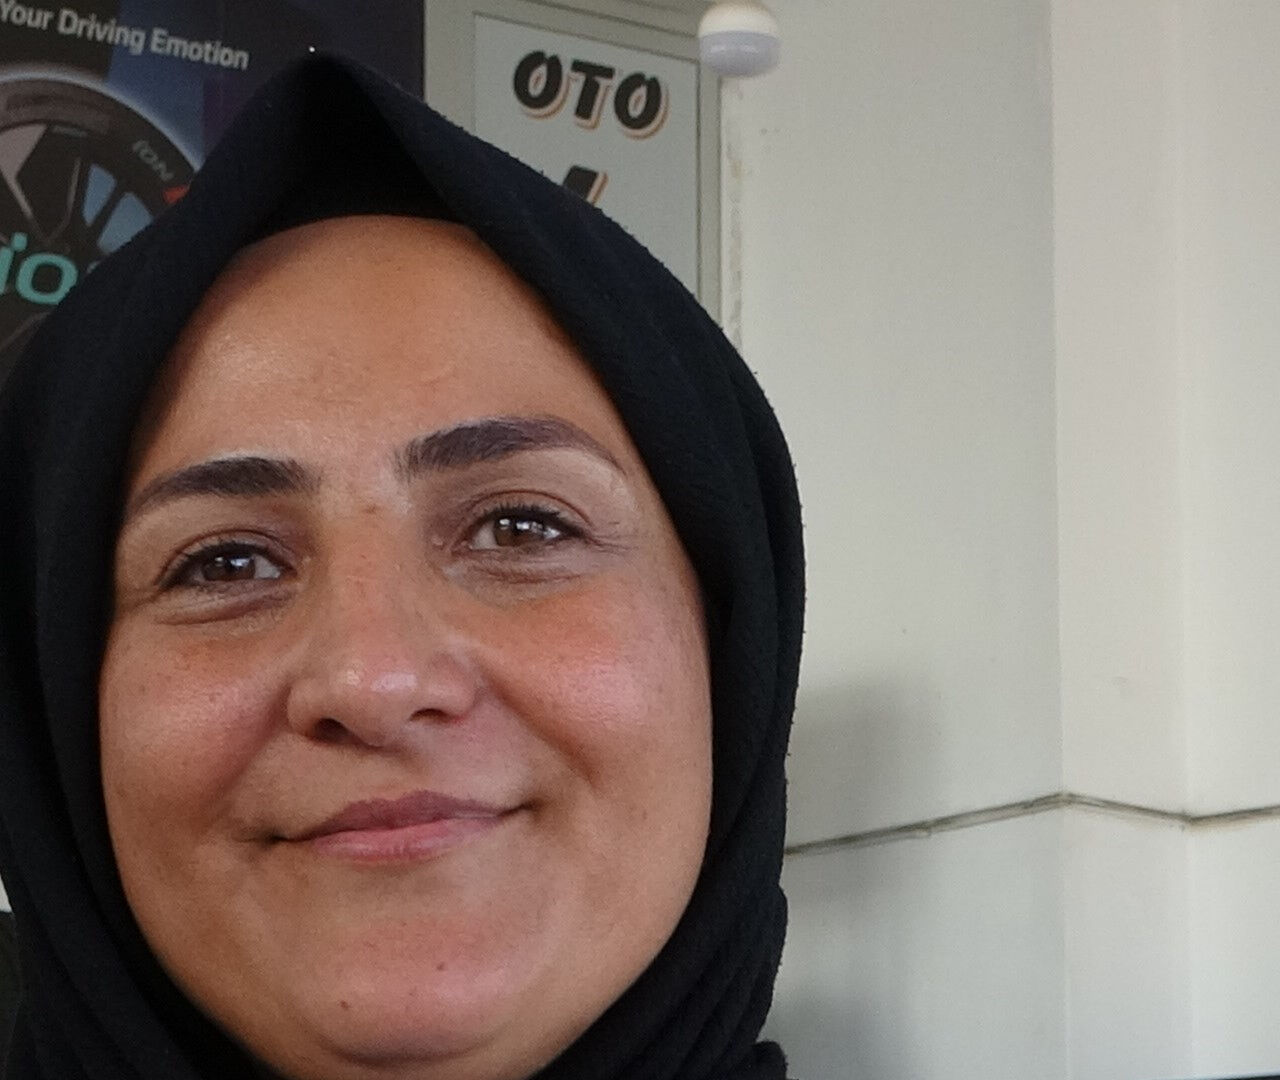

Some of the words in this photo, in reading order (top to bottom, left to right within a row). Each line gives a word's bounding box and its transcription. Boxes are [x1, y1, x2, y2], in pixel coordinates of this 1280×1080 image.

[58, 9, 146, 56] Driving
[150, 28, 251, 71] Emotion
[513, 51, 669, 139] OTO
